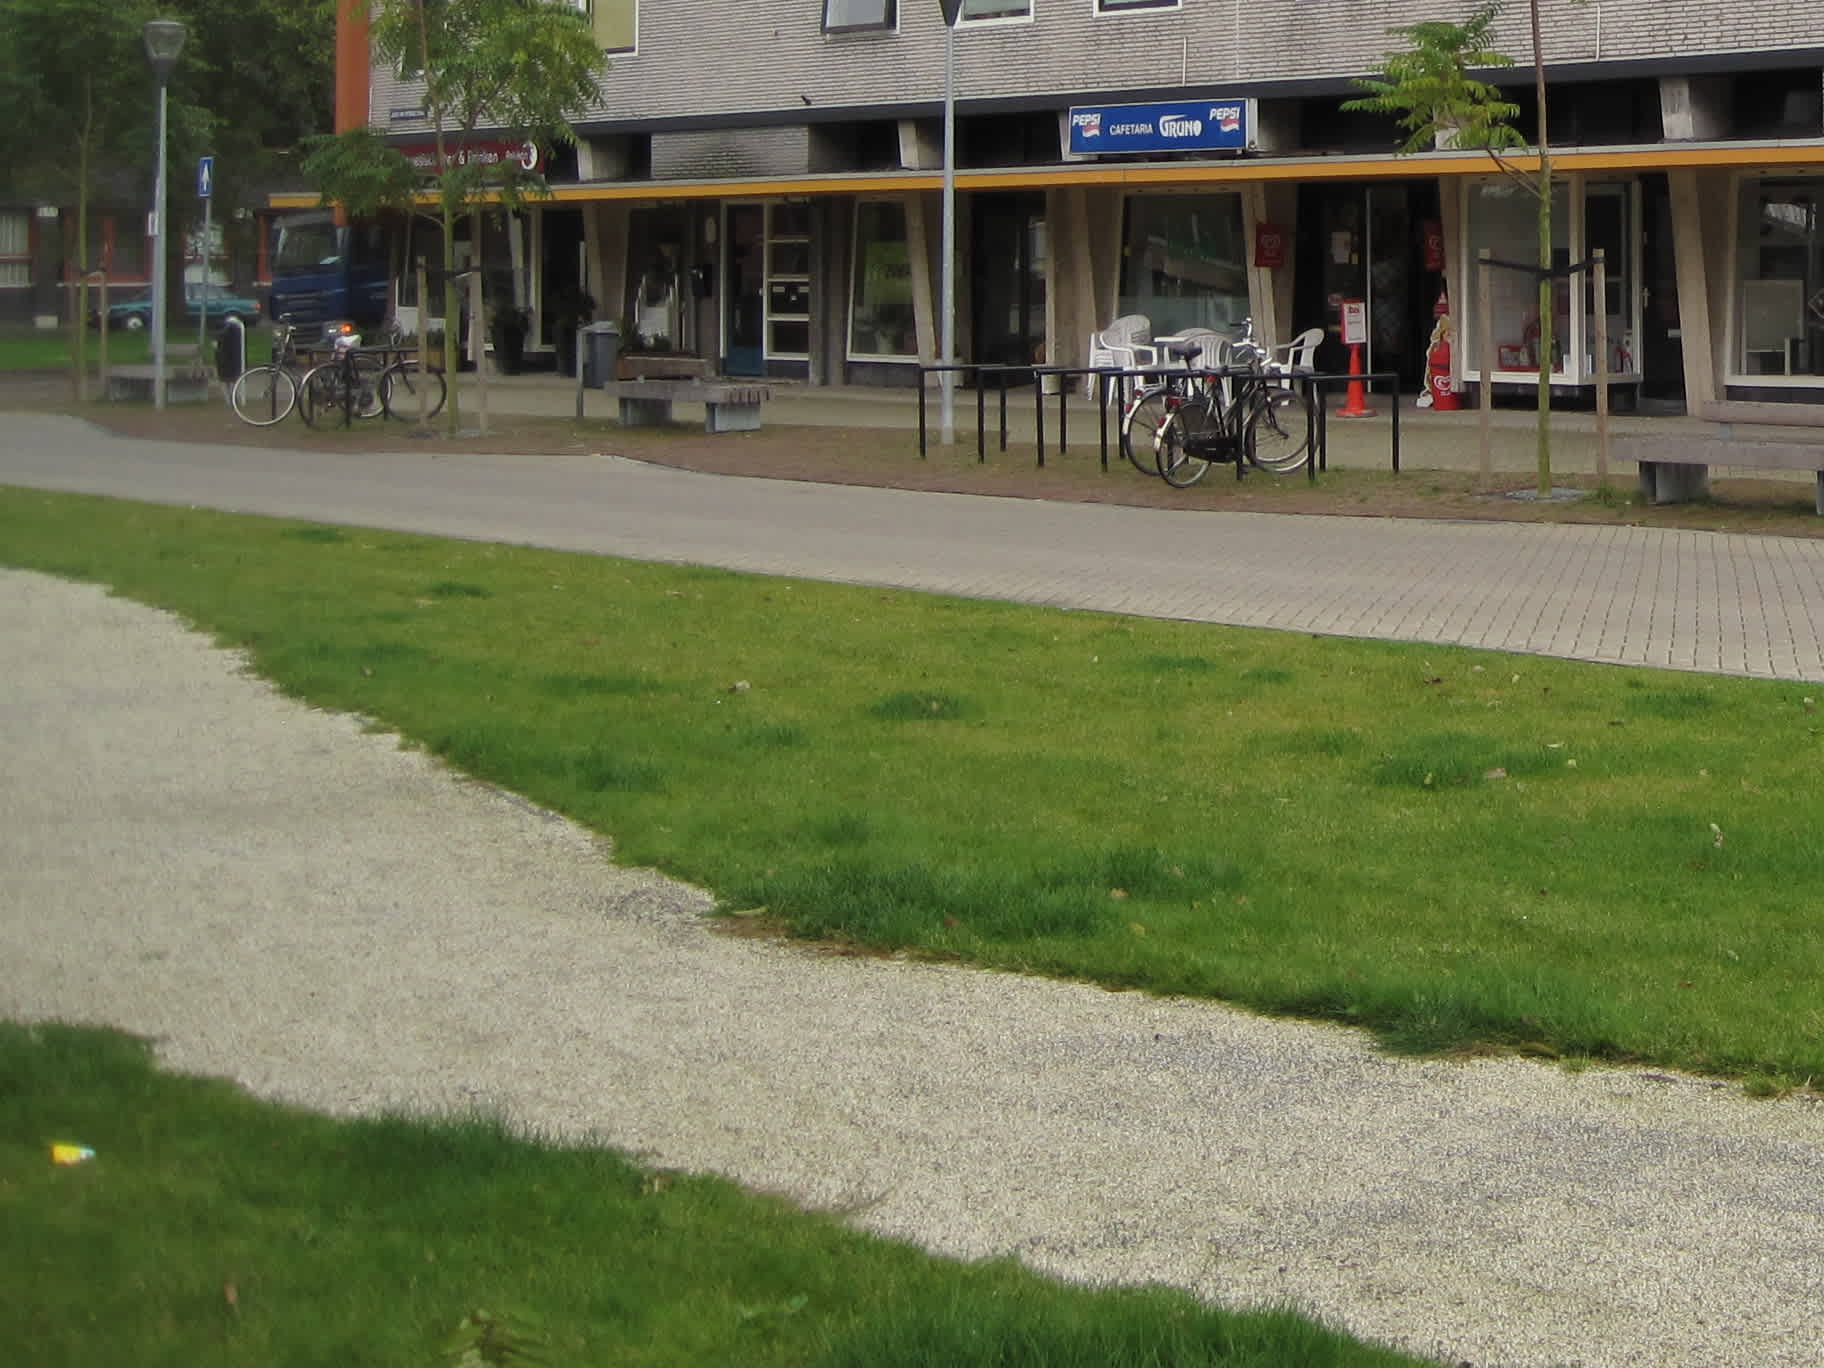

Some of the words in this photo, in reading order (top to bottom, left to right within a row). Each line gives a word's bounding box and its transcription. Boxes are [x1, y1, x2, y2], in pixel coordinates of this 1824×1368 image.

[1072, 113, 1101, 127] PEPSI
[1209, 106, 1241, 120] PEPSI
[1109, 123, 1153, 135] CAFETARIA
[1159, 114, 1202, 138] GRUNO
